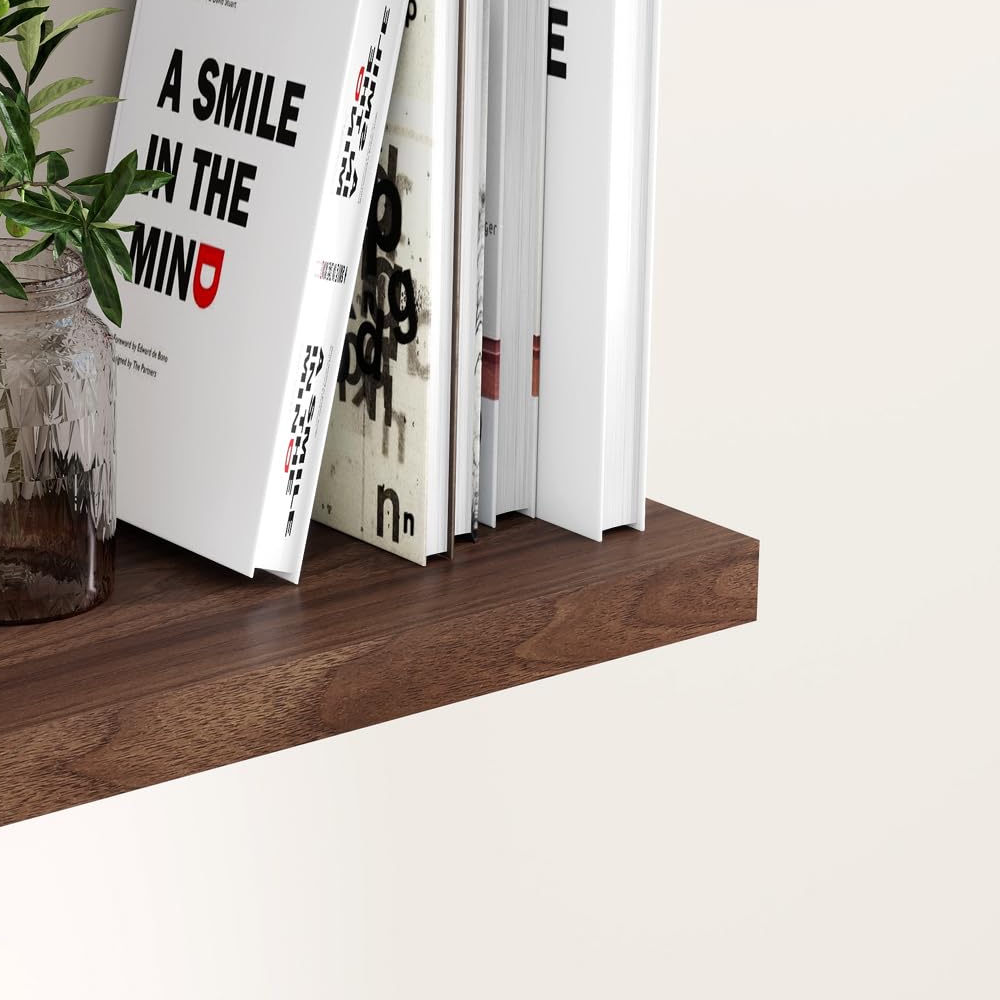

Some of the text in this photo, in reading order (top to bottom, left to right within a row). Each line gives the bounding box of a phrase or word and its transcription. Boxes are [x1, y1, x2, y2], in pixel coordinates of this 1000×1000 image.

[157, 48, 306, 148] A SMILE
[190, 147, 258, 228] THE
